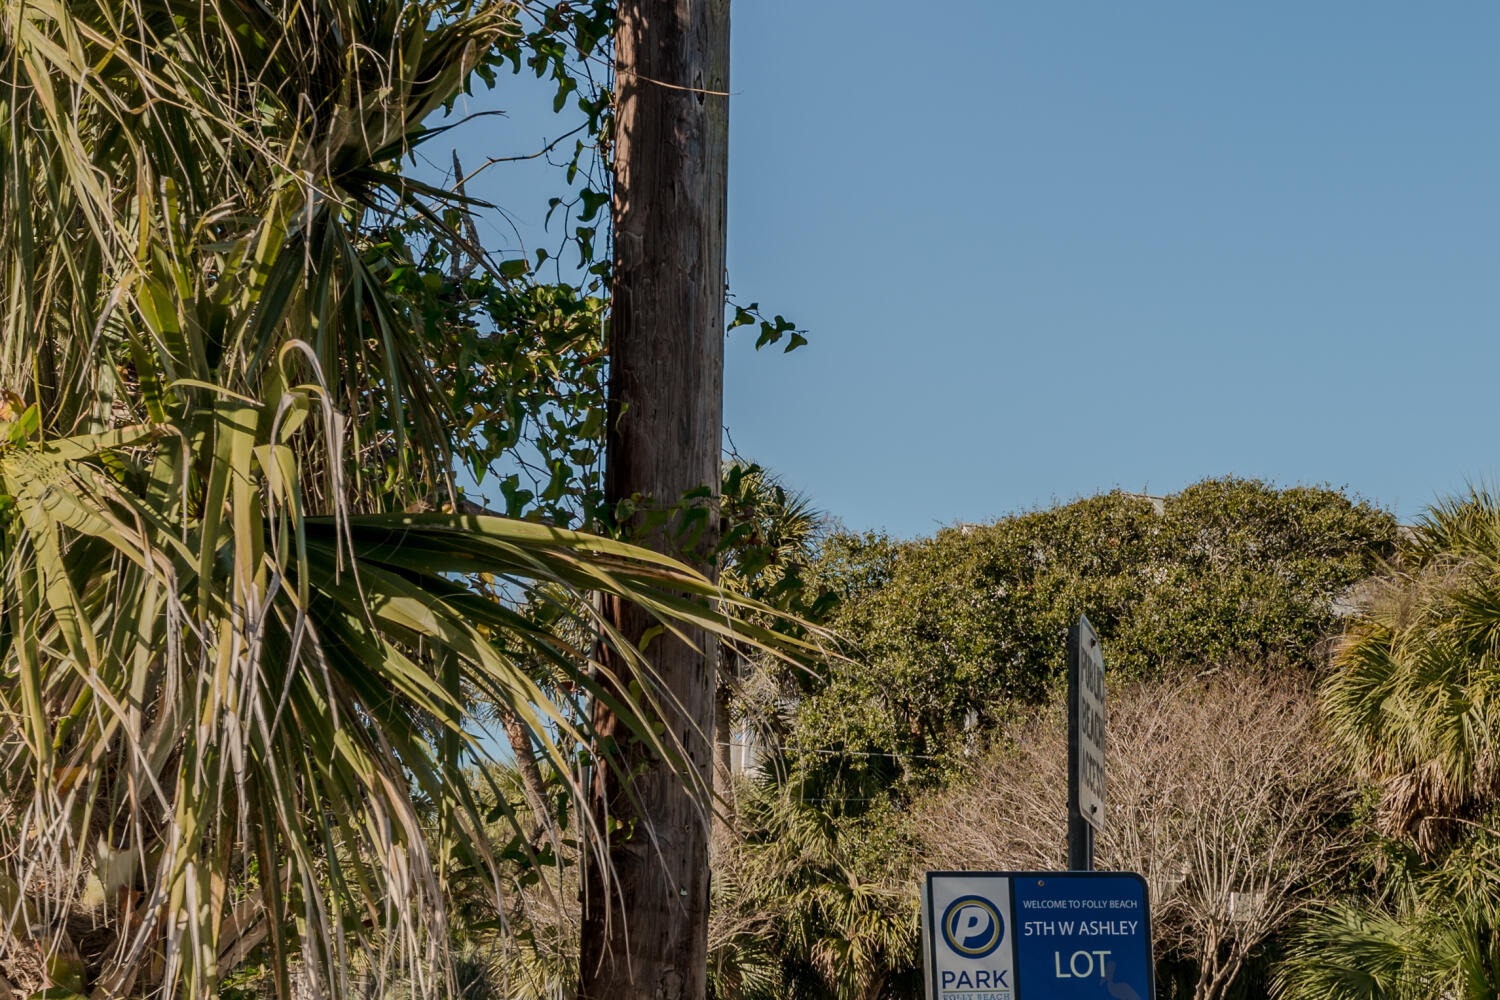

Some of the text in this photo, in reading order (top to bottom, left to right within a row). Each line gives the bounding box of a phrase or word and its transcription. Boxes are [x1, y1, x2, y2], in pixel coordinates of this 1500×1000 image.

[1081, 646, 1104, 704] PUBLIC
[1082, 696, 1104, 753] BEACH
[1082, 747, 1104, 803] ACCESS
[1023, 900, 1138, 909] WELCOME TO FOLLY BEACH
[954, 906, 990, 947] P
[1024, 921, 1138, 936] 5TH W ASHLEY
[942, 970, 1009, 989] PARK
[1055, 950, 1111, 978] LOT
